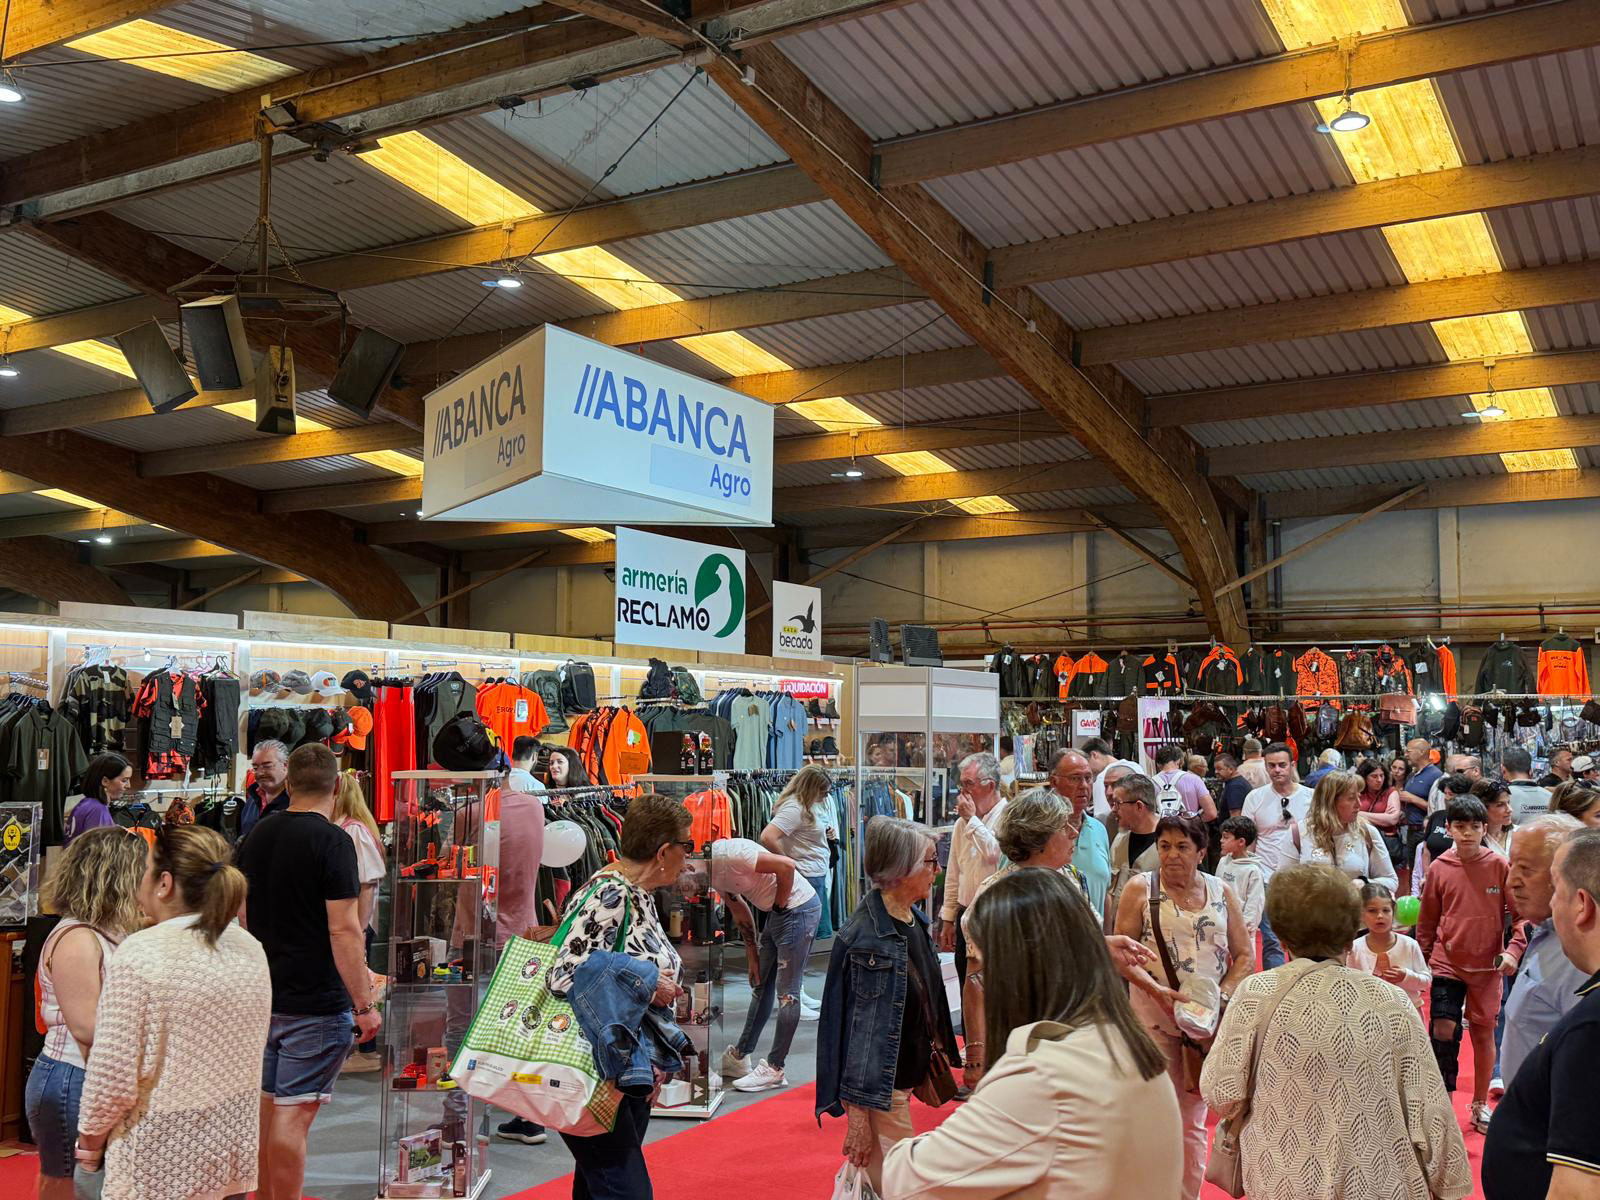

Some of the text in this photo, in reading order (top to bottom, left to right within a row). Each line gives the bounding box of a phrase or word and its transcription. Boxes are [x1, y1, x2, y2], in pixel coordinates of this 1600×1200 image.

[497, 433, 526, 467] Agro
[709, 463, 751, 498] Agro
[622, 566, 688, 595] armería
[617, 597, 710, 631] RECLAMO
[779, 632, 813, 650] becada
